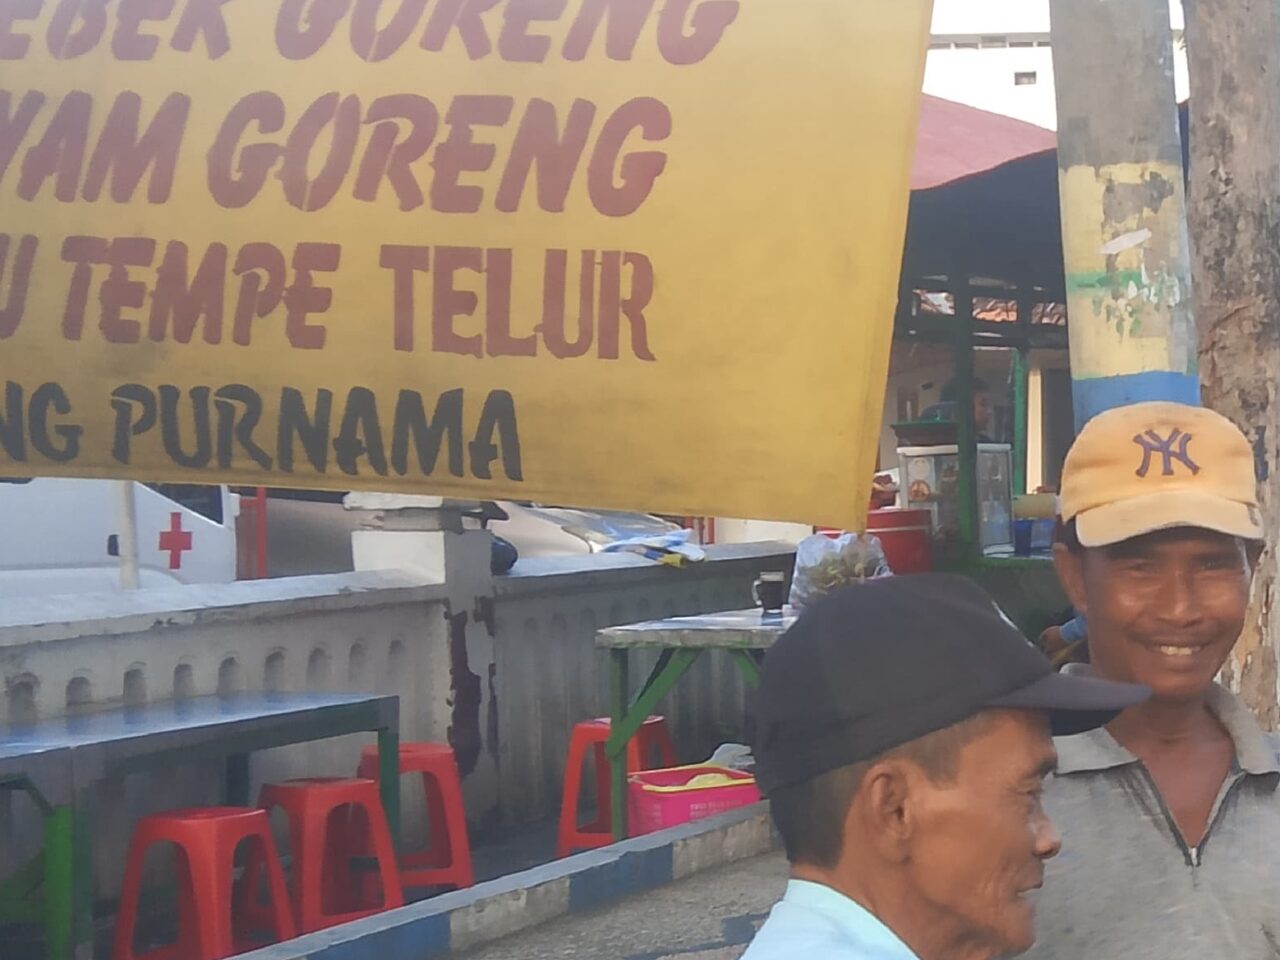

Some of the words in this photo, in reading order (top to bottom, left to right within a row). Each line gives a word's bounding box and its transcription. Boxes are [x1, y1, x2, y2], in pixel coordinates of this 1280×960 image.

[274, 0, 740, 65] GORENG
[206, 90, 672, 217] GORENG
[61, 235, 341, 350] TEMPE
[380, 244, 657, 362] TELUR
[111, 383, 523, 482] PURNAMA
[1132, 427, 1200, 478] NY
